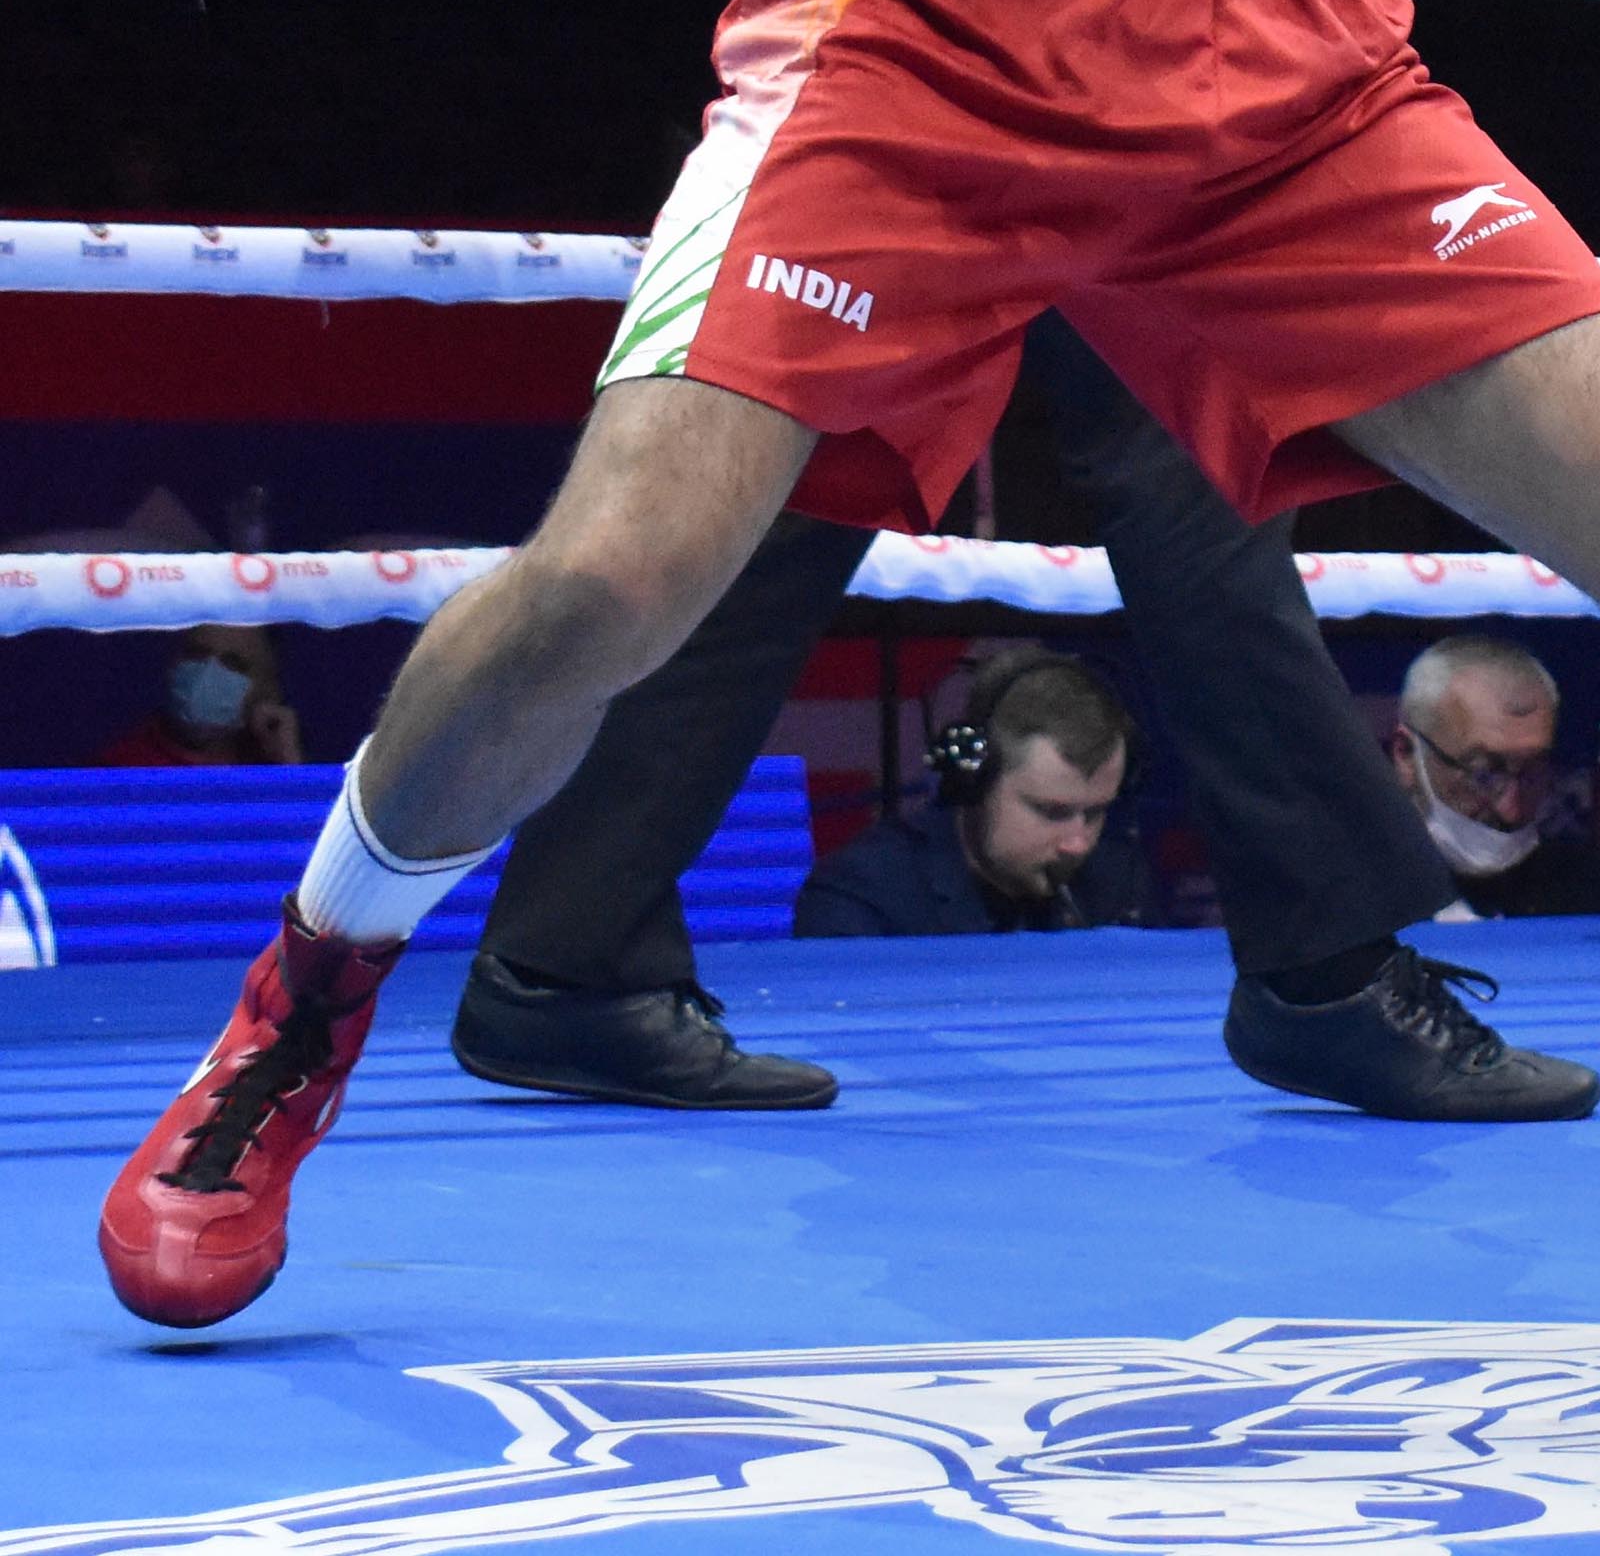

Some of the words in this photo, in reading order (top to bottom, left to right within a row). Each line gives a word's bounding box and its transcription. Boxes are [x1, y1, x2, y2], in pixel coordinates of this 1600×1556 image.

[1436, 209, 1538, 262] SHIV-NARESH
[746, 254, 874, 332] INDIA
[138, 564, 185, 582] mts
[282, 560, 330, 577] mts
